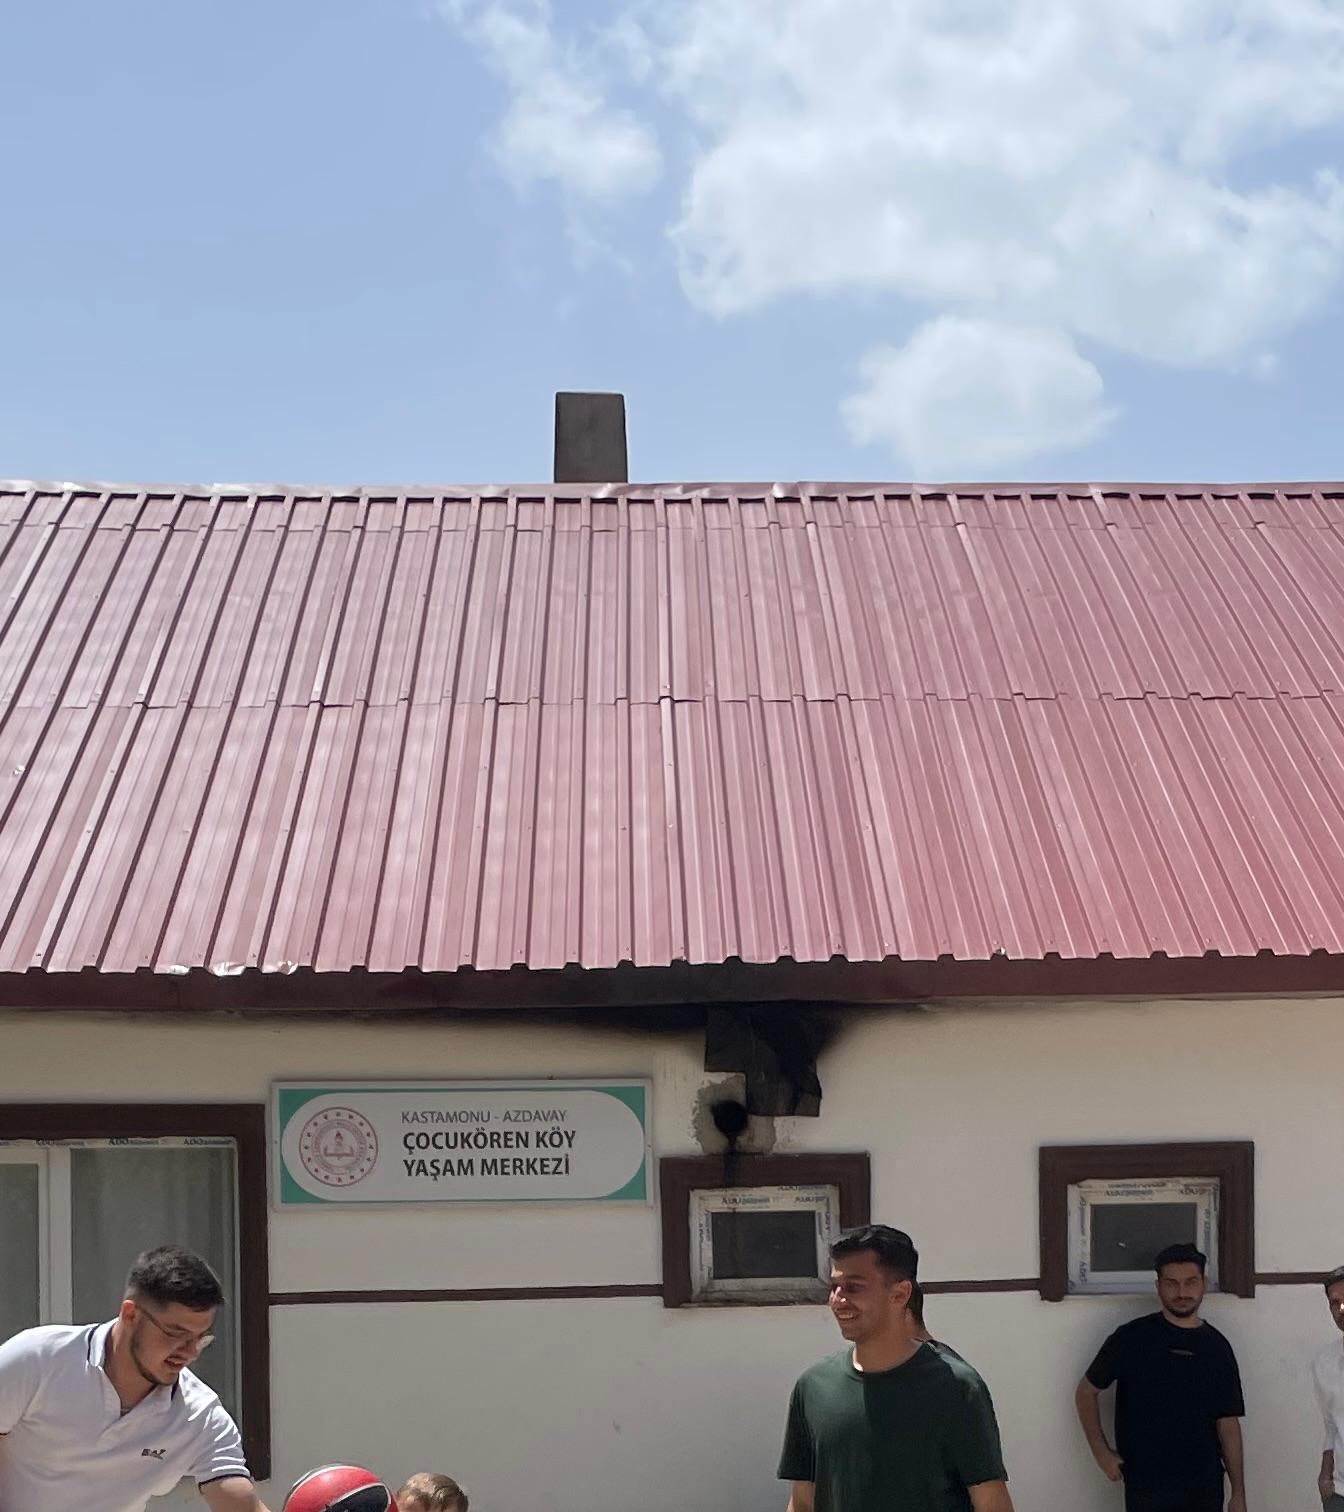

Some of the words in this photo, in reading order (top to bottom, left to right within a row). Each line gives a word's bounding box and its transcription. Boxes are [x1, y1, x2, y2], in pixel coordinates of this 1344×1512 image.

[401, 1110, 492, 1124] KASTAMONU
[502, 1109, 568, 1123] AZDAVAY
[402, 1127, 530, 1155] ÇOCUKÖREN
[535, 1125, 577, 1149] KÖY
[402, 1156, 475, 1182] YAŞAM
[480, 1153, 571, 1177] MERKEZİ
